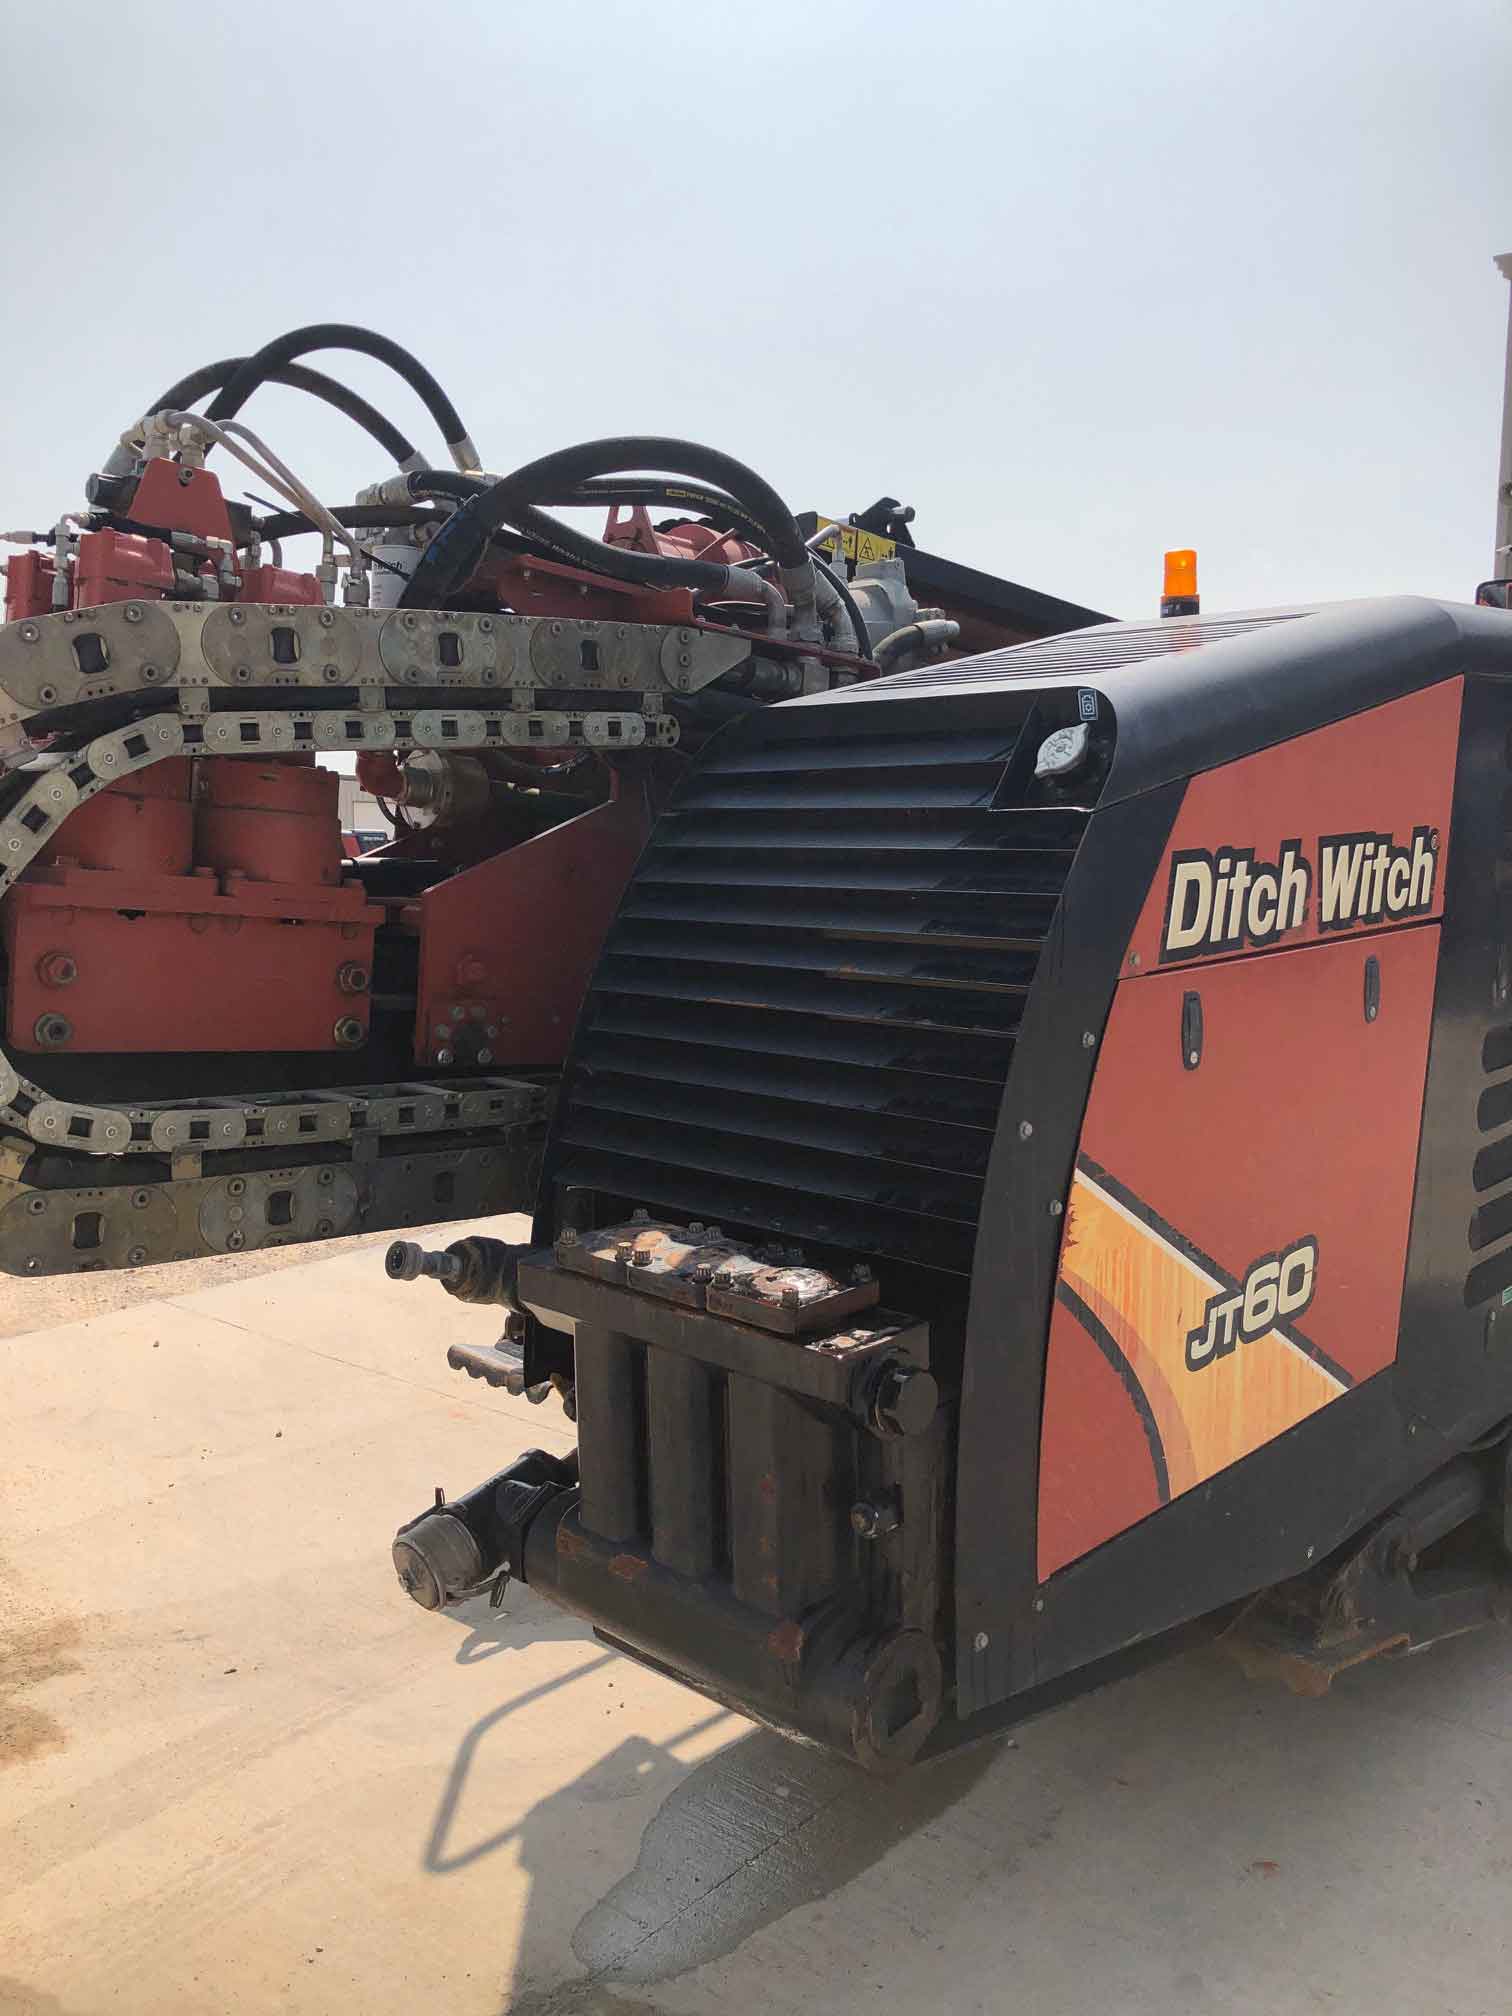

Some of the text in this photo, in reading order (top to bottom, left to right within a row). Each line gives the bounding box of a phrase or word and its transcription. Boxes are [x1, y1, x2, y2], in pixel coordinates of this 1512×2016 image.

[1165, 836, 1435, 951] Ditch Witch
[1190, 1245, 1315, 1361] JT60
